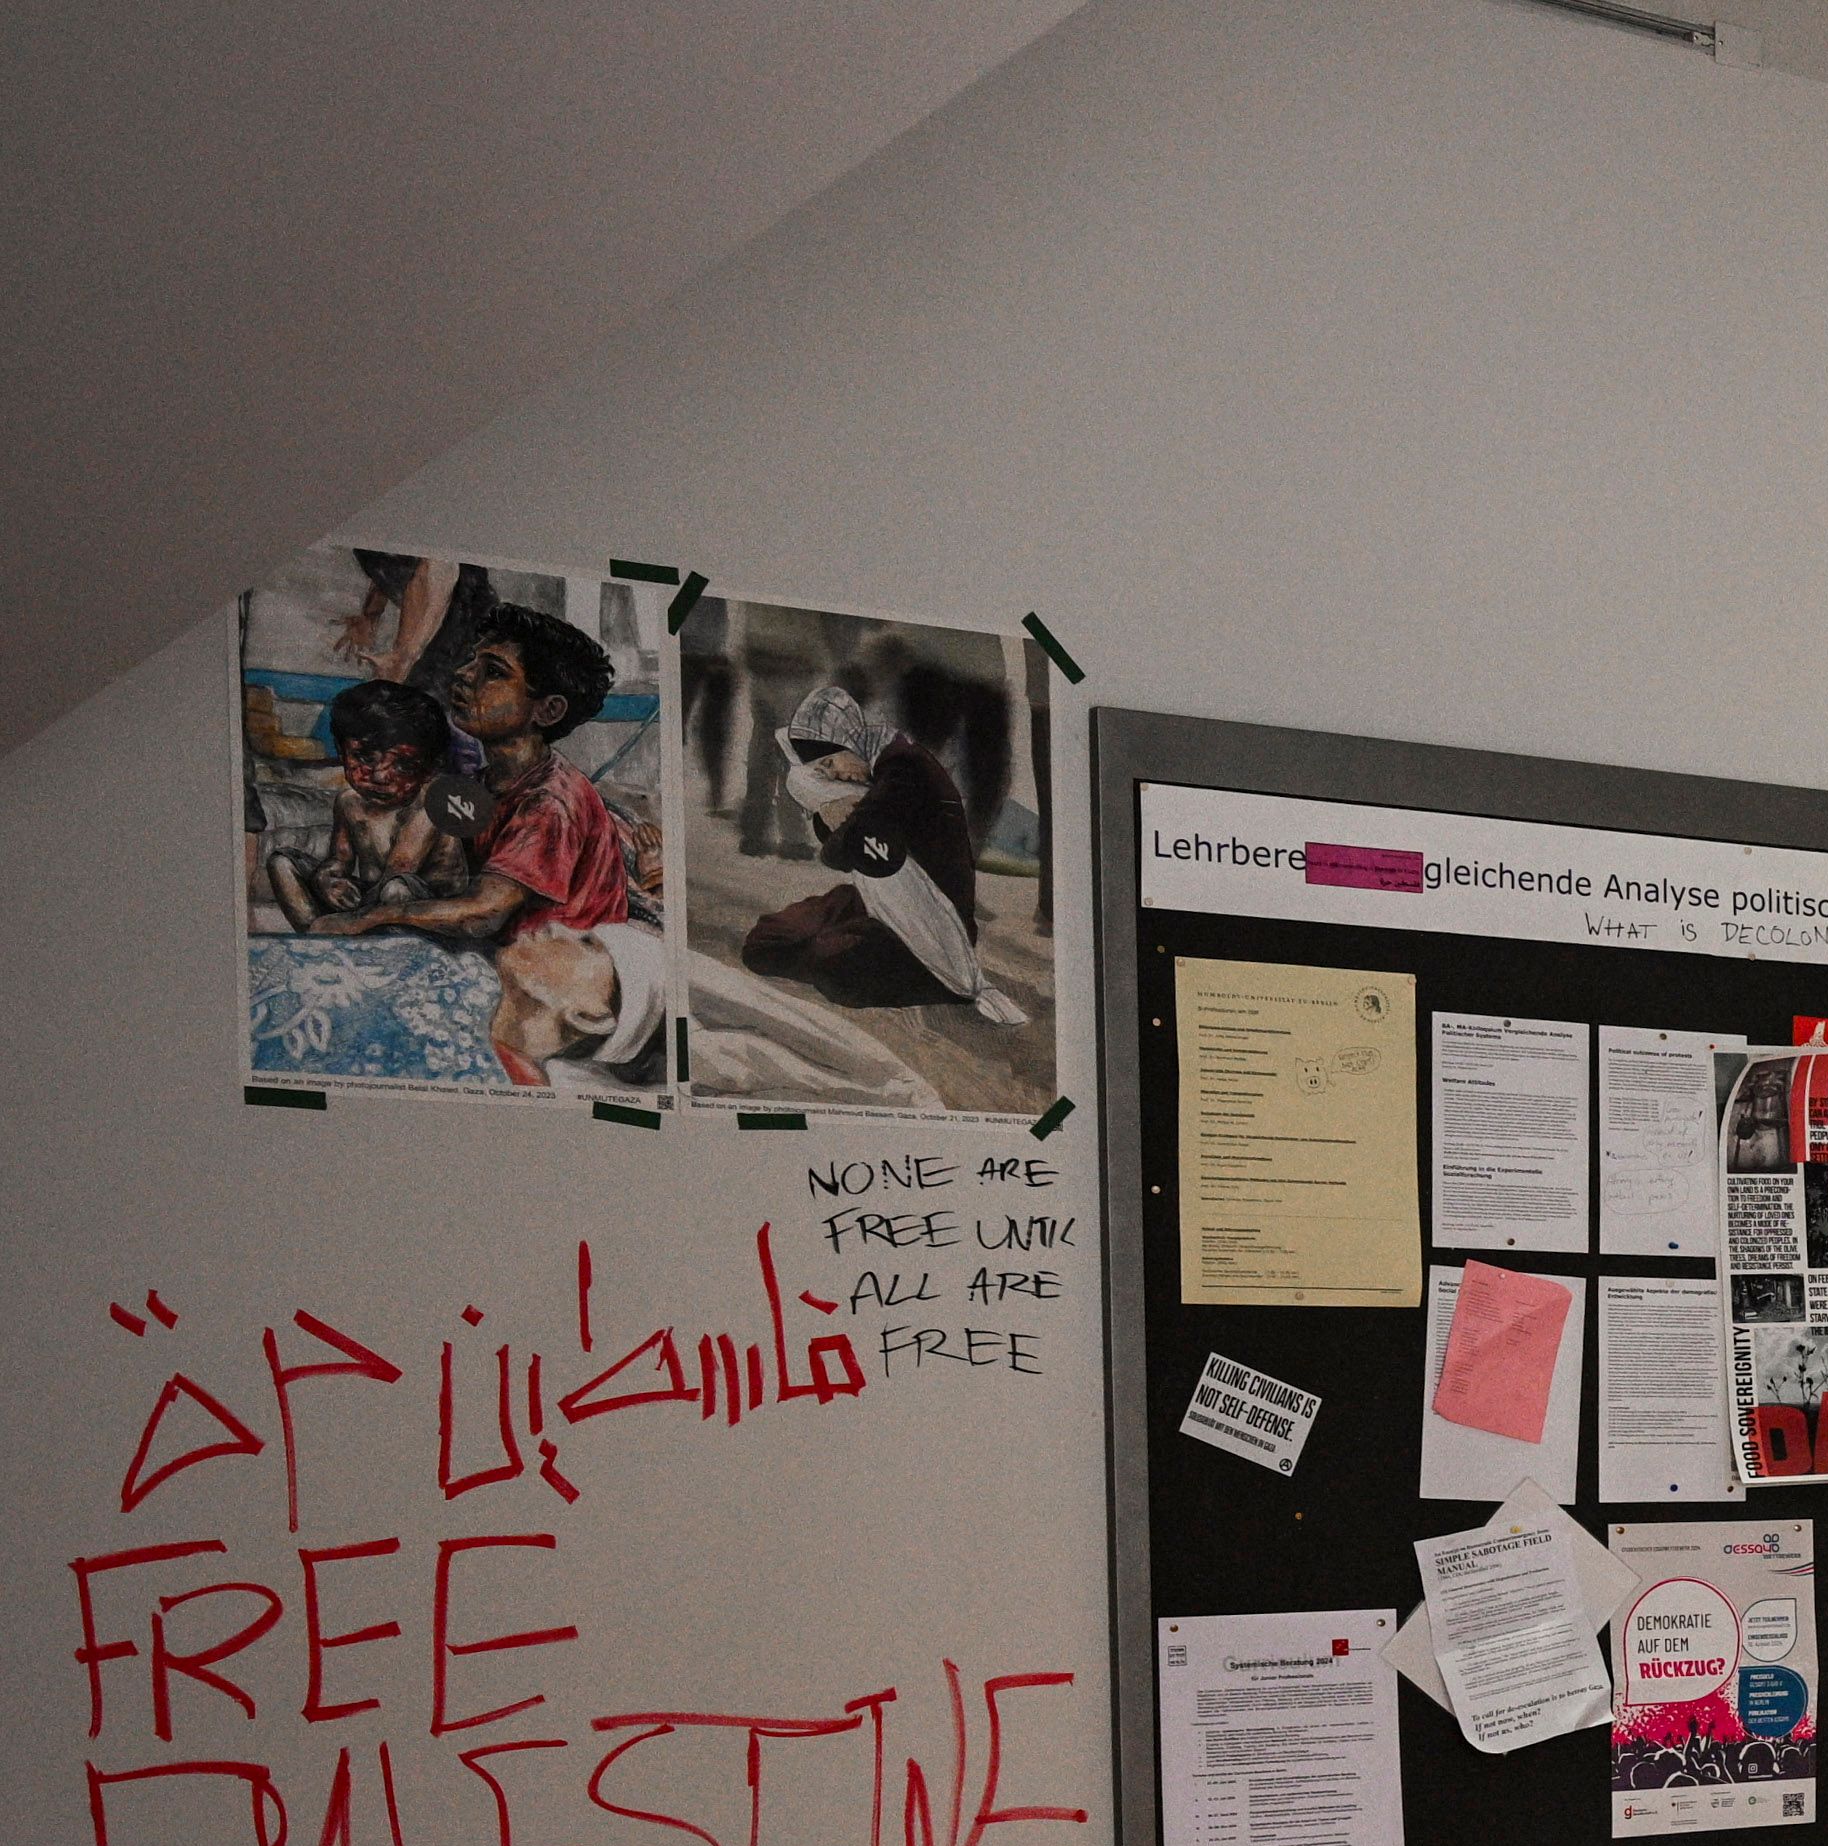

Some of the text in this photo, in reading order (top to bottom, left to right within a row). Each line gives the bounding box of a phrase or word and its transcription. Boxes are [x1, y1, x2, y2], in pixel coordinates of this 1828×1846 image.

[1154, 829, 1308, 871] Lehrbere
[1423, 855, 1592, 897] gleichende
[1604, 873, 1721, 914] Analyse
[1584, 911, 1659, 942] WHAT
[808, 1154, 1060, 1199] NONE ARE
[821, 1206, 963, 1254] FREE
[850, 1266, 1065, 1315] ALL ARE
[879, 1322, 1044, 1378] FREE
[1195, 1384, 1222, 1410] NOT
[1206, 1358, 1316, 1418] KILLING CIVILIANS IS
[1733, 1325, 1763, 1479] FOOD SOVEREIGNITY
[1435, 1552, 1469, 1567] SIMPLE
[1472, 1540, 1520, 1558] SABOTAGE
[1523, 1534, 1552, 1548] FIELD
[1437, 1560, 1479, 1576] MANUAL
[70, 1534, 579, 1740] FREE
[1637, 1614, 1712, 1631] DEMOKRATIE
[1637, 1638, 1689, 1654] AUF DEM
[1639, 1657, 1726, 1679] RÜCKZUG?
[1482, 1710, 1494, 1720] call
